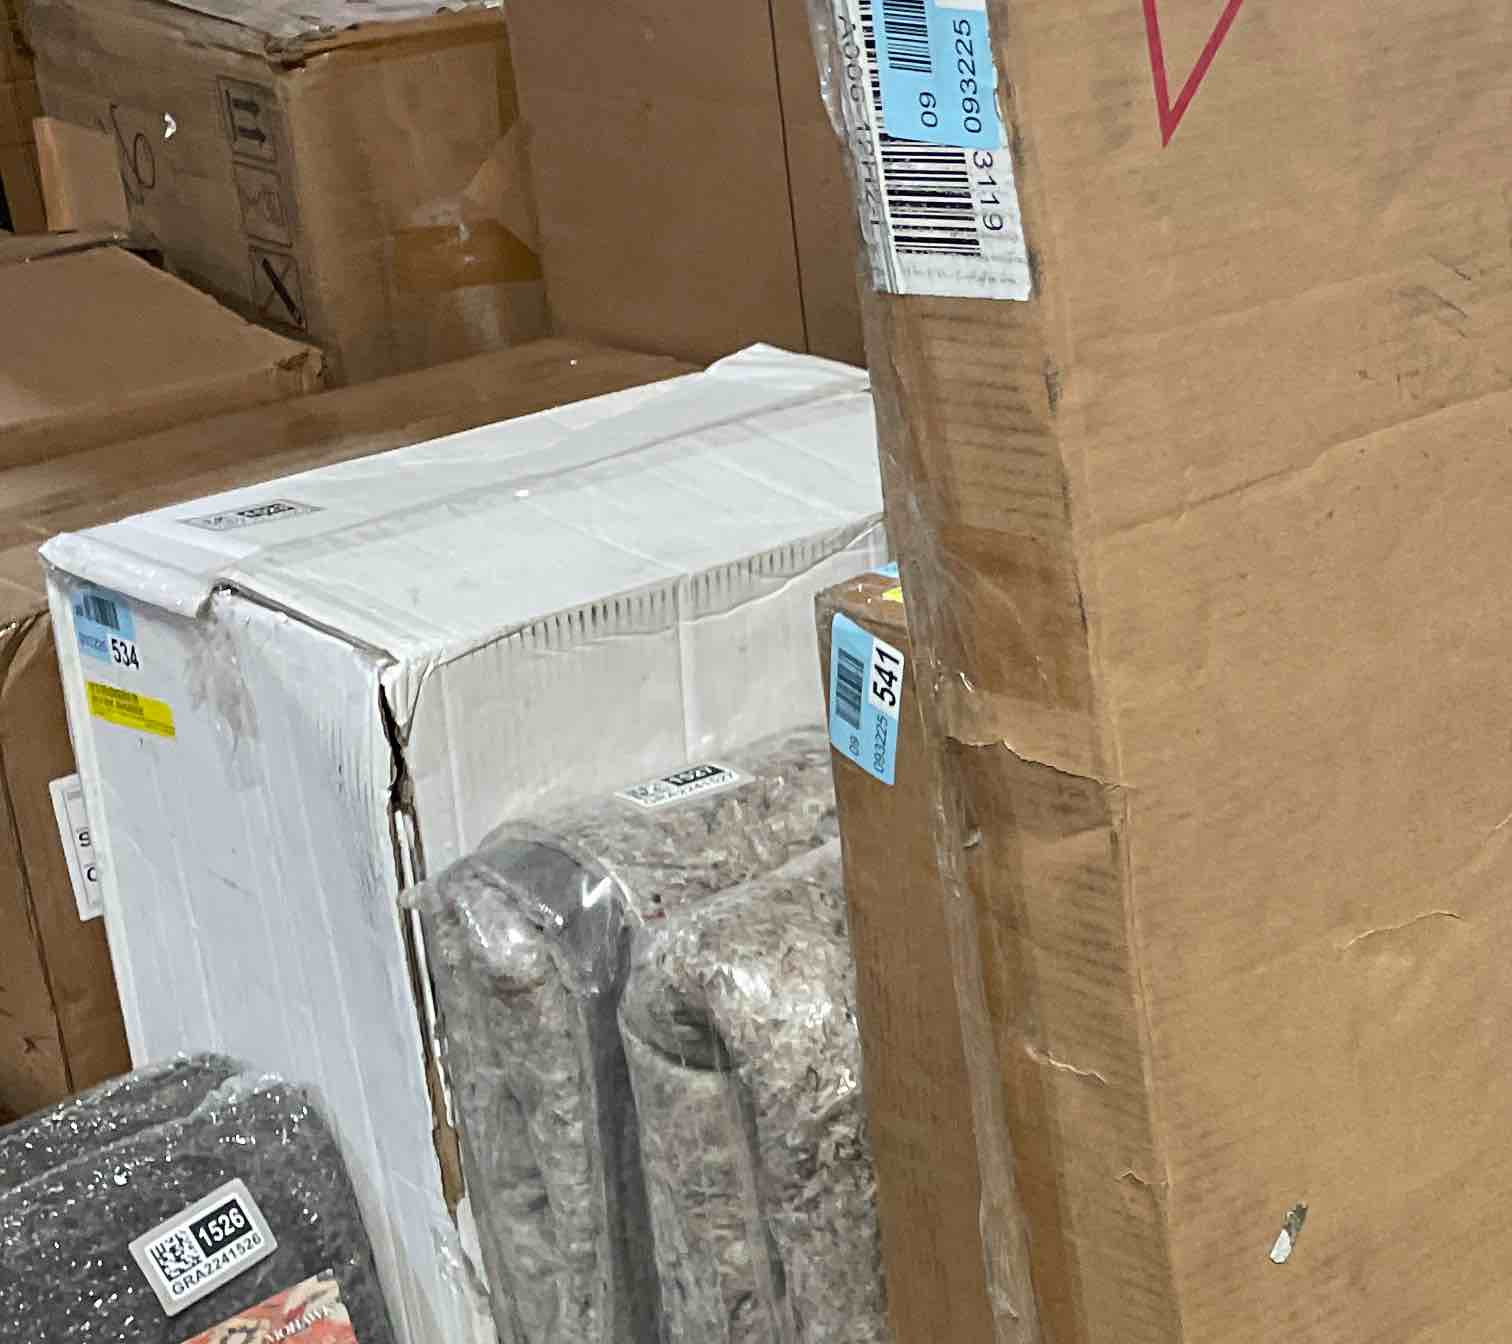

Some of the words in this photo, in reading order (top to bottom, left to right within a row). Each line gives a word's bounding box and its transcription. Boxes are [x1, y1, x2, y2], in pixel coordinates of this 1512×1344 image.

[952, 18, 984, 134] 093225
[919, 90, 939, 129] 09
[111, 637, 140, 671] 534
[872, 646, 900, 707] 541
[198, 1205, 246, 1250] 1526
